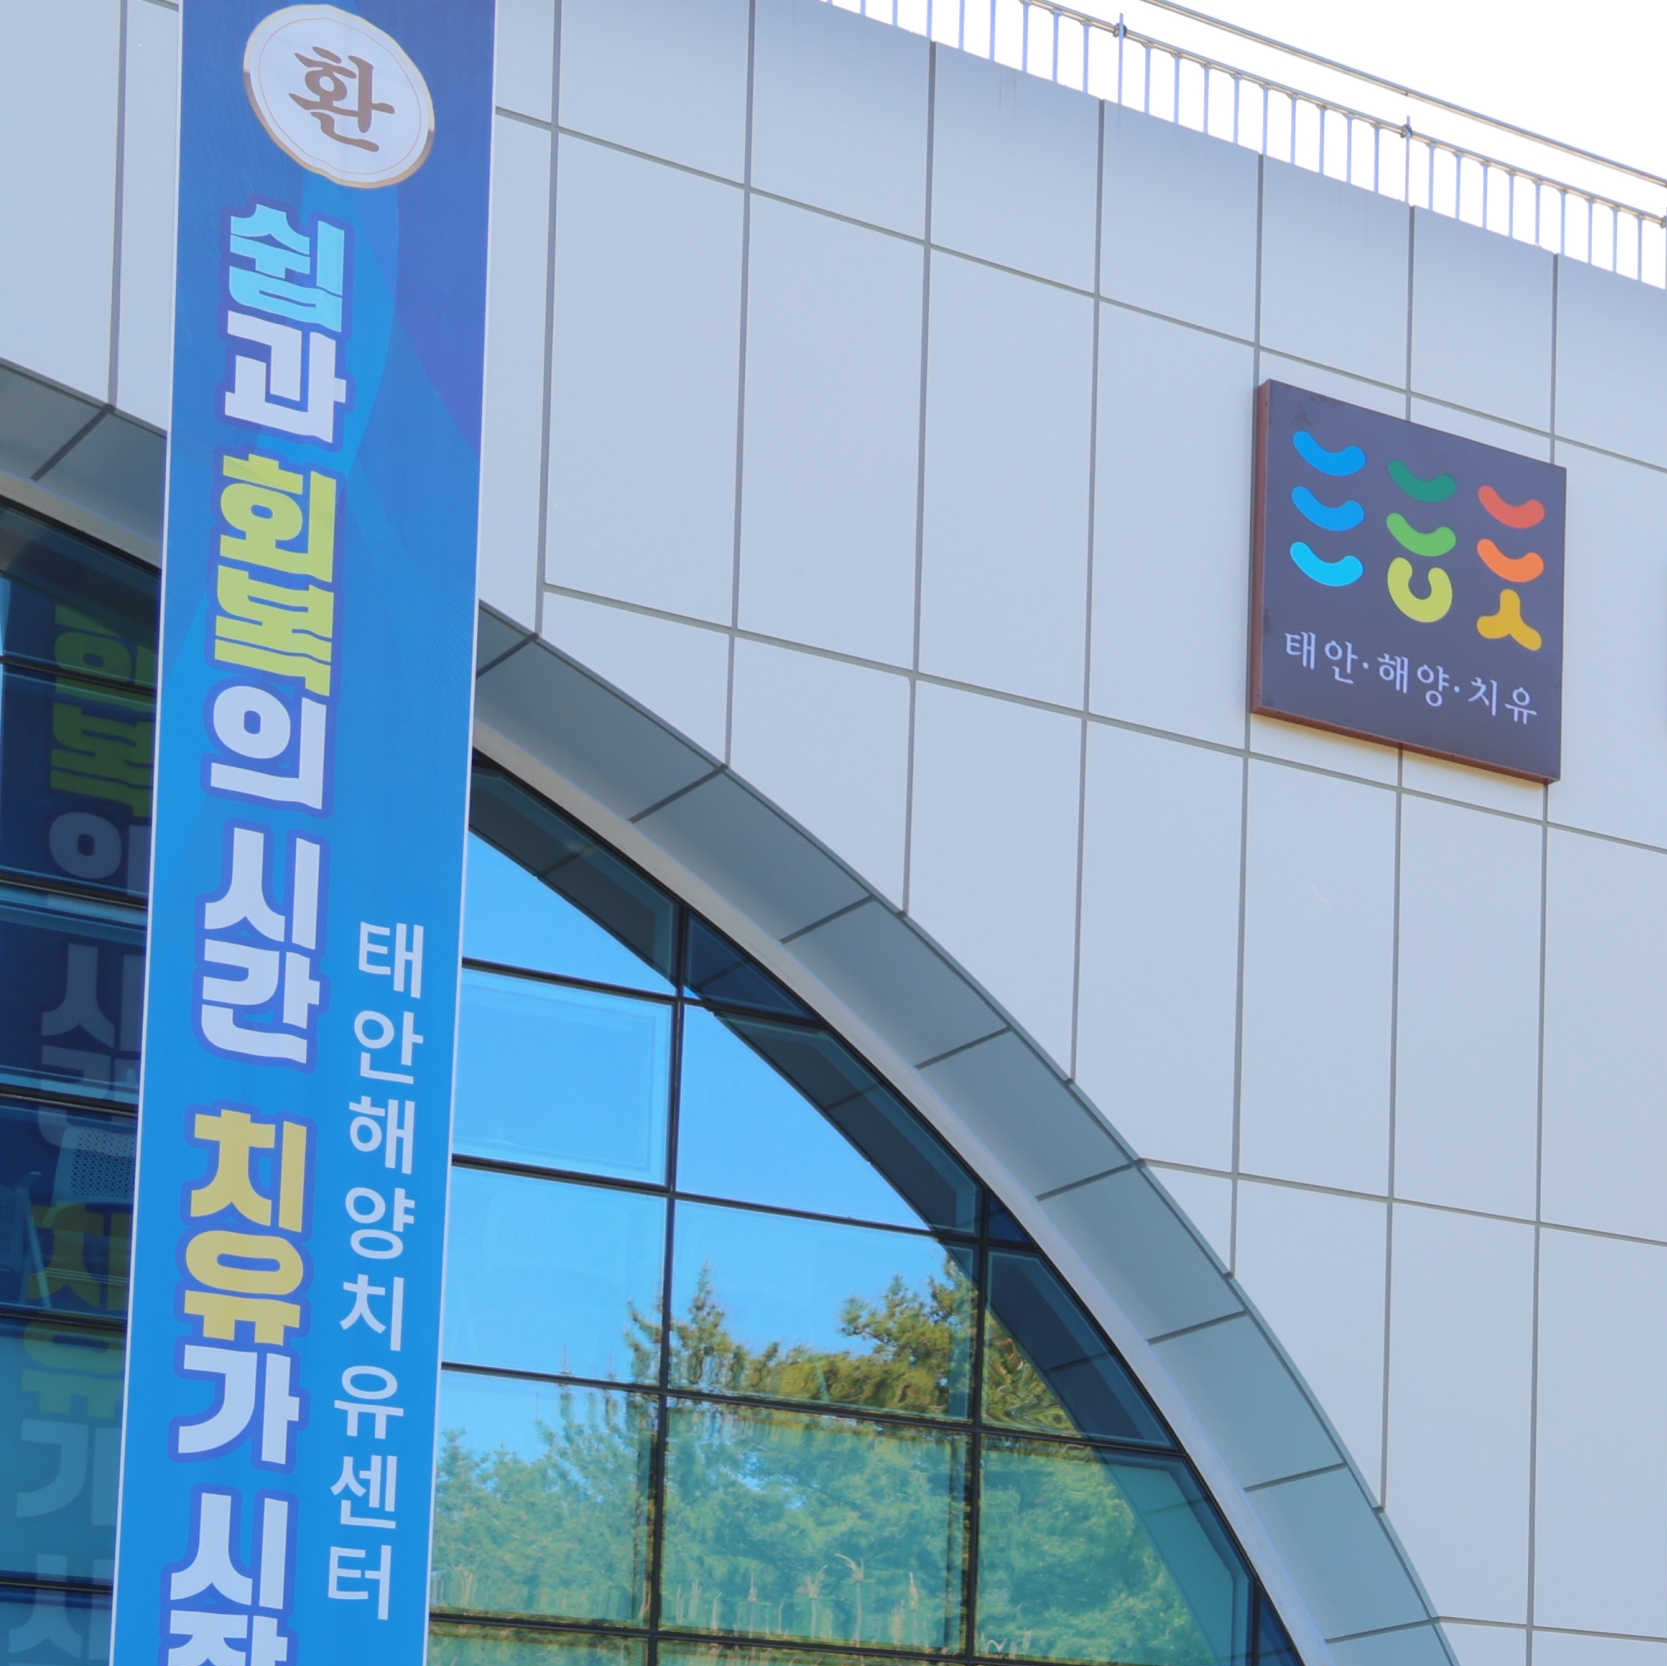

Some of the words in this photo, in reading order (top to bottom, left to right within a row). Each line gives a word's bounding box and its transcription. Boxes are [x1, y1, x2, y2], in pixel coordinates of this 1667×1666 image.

[290, 46, 395, 152] 환
[223, 203, 348, 445] 쉼과
[210, 453, 339, 810] 회복의
[202, 827, 322, 1064] 시간
[177, 1109, 308, 1465] 치유가
[328, 921, 425, 1620] 태안해양치유센터
